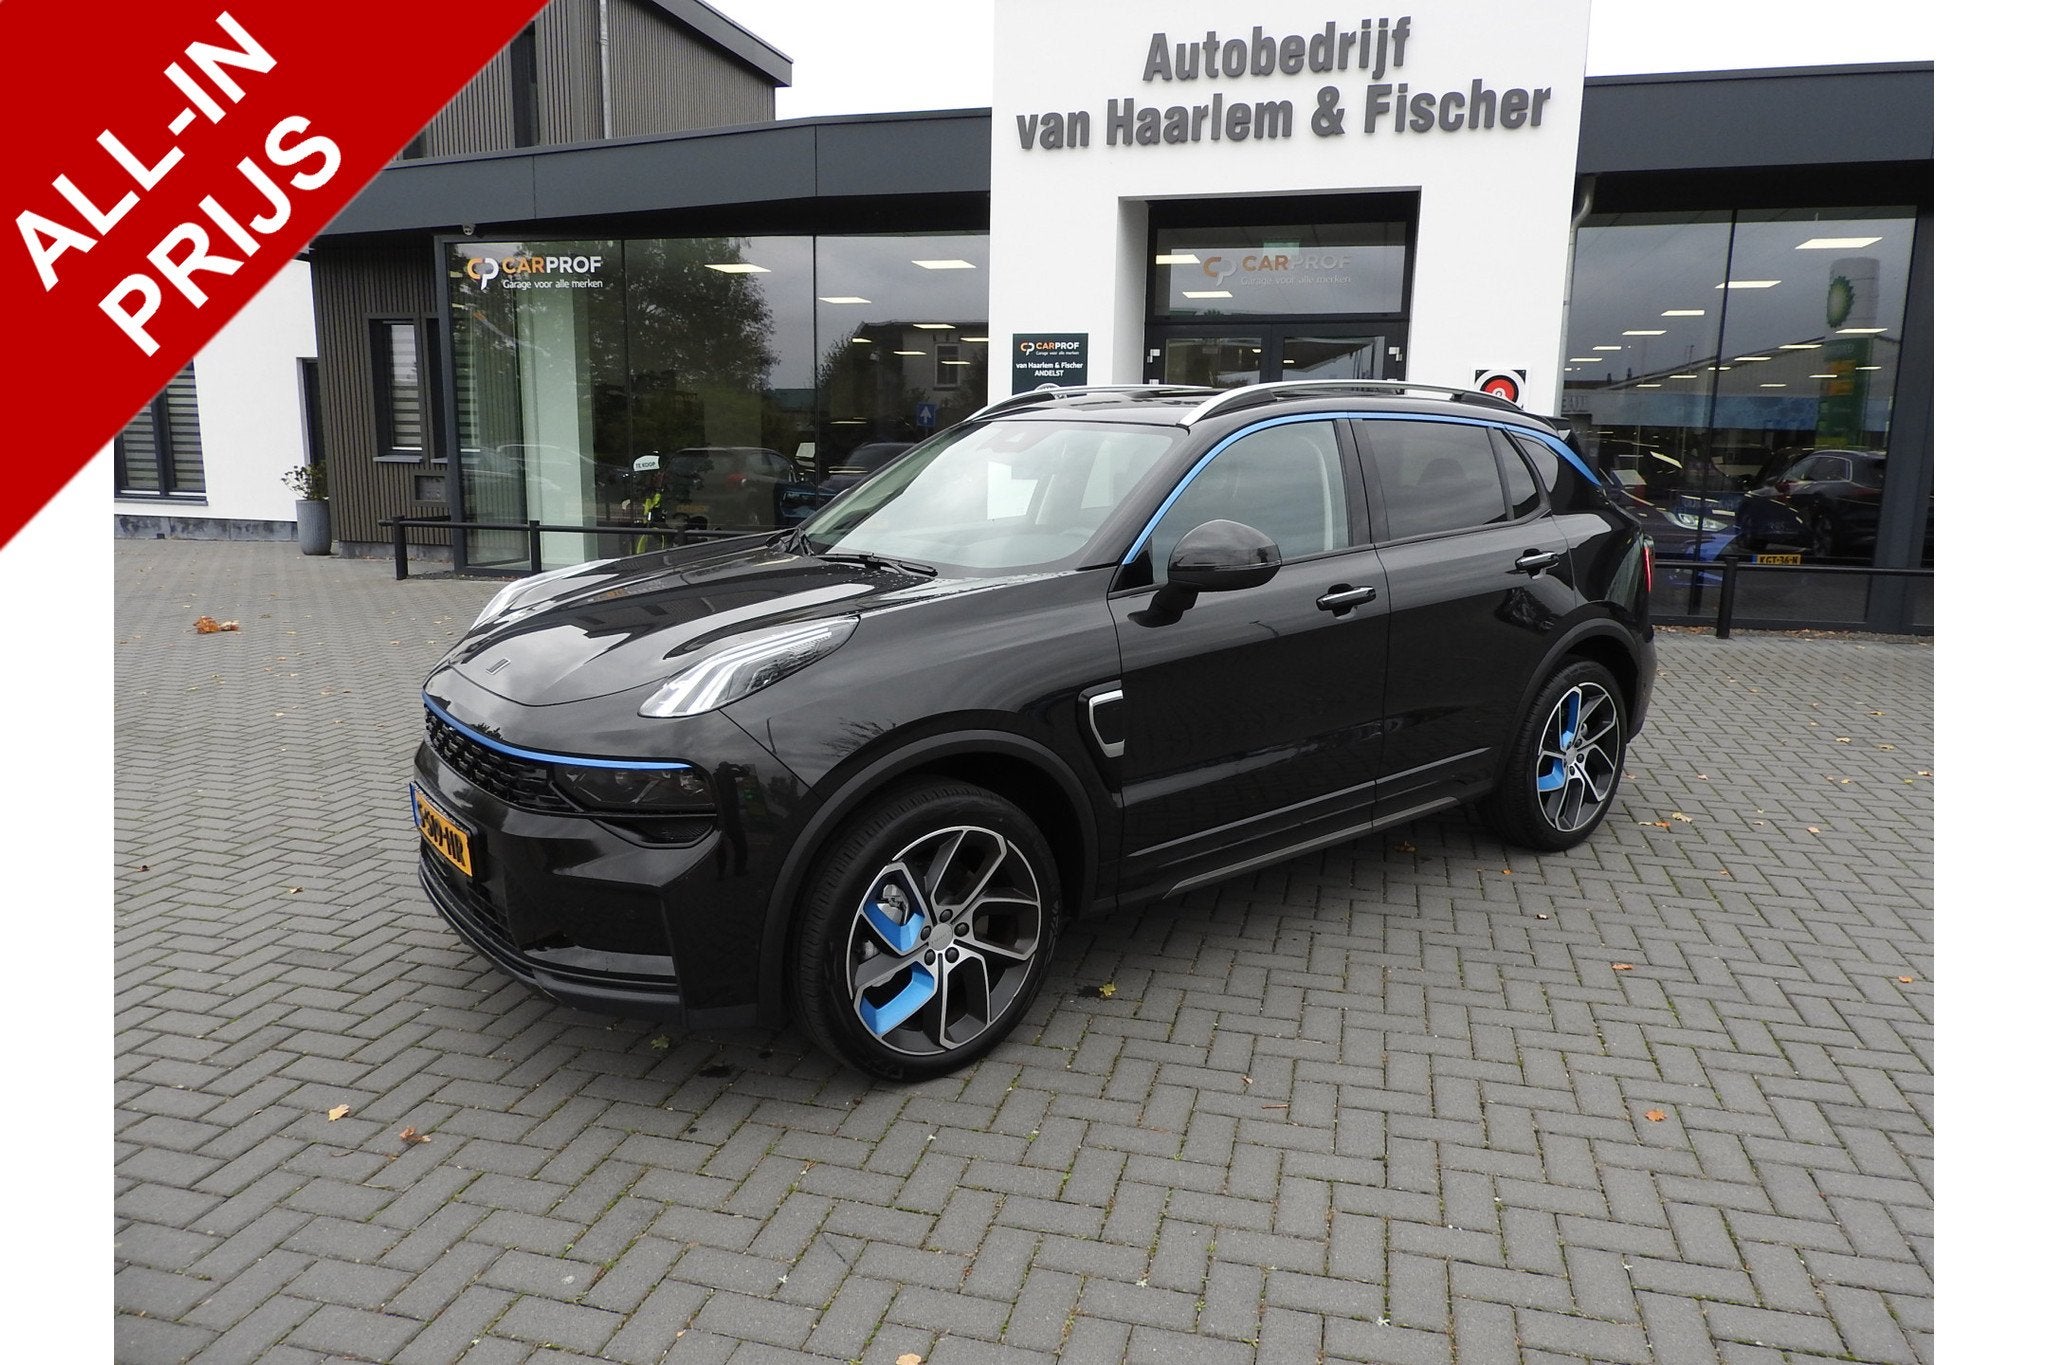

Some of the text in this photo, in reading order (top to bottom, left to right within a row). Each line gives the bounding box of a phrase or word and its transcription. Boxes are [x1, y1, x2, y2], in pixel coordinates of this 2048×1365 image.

[1142, 16, 1412, 82] Autobedrijf
[1016, 78, 1552, 150] van Haarlem & Fischer
[502, 256, 602, 274] CARPROF
[1242, 254, 1352, 272] CARPROF
[502, 279, 604, 291] Garage voor alle merken
